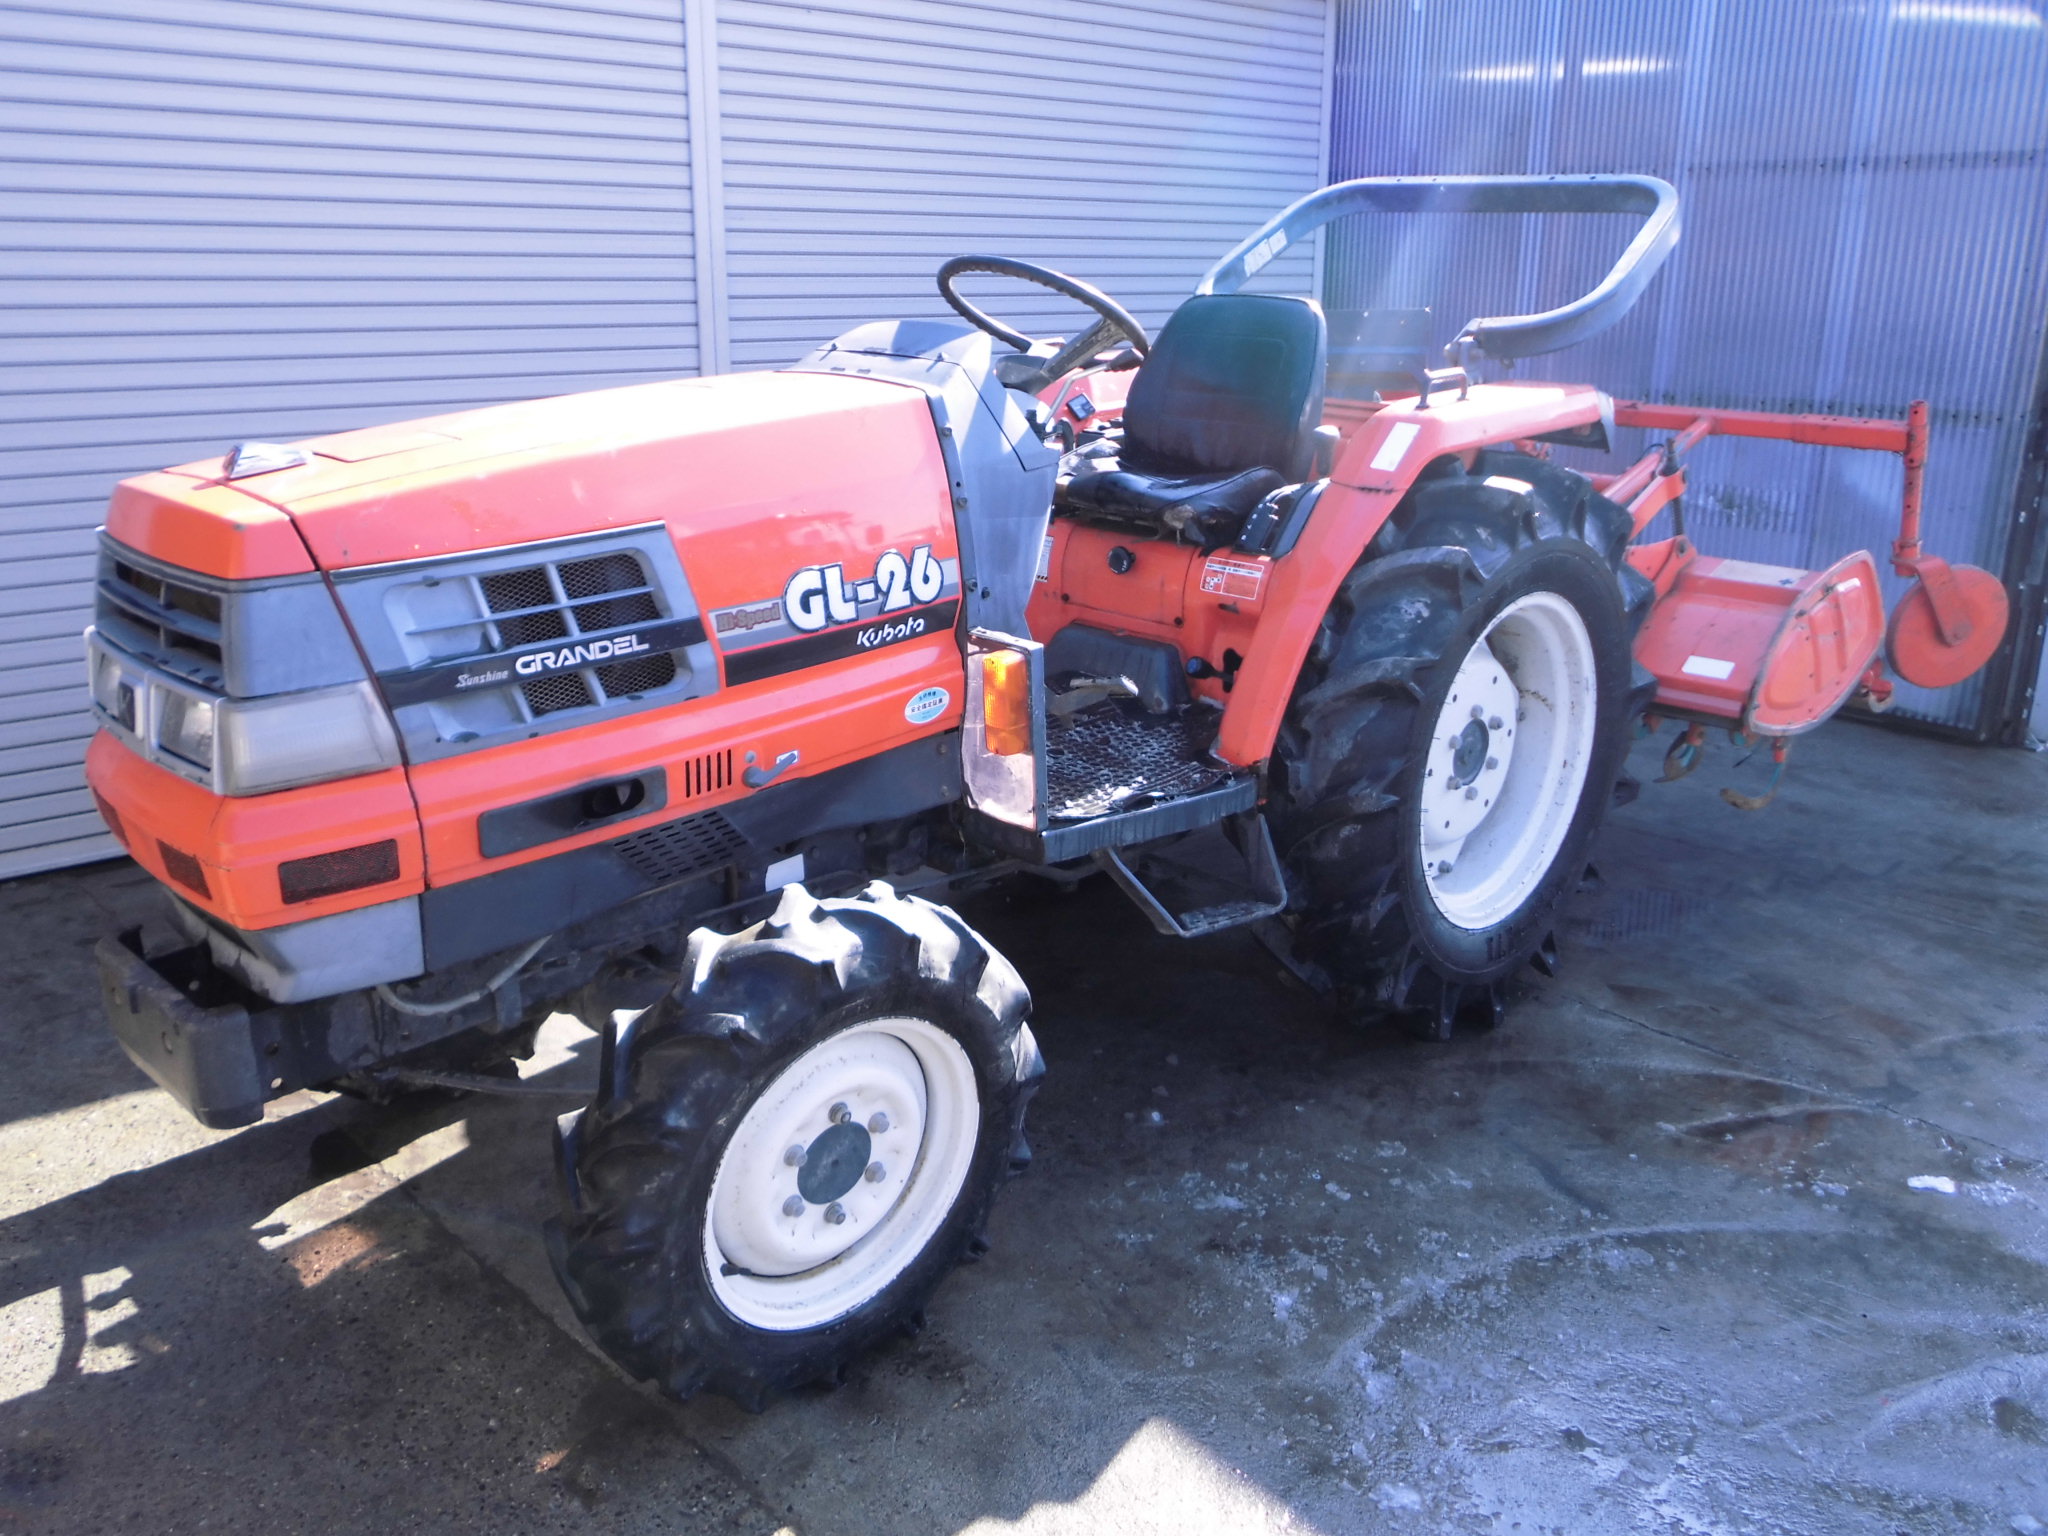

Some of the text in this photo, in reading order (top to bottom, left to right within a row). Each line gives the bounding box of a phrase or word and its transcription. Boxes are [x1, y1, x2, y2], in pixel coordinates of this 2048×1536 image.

[784, 544, 944, 633] GL-26
[857, 616, 925, 647] Kubota
[455, 635, 649, 688] Sunshine GRANDEL
